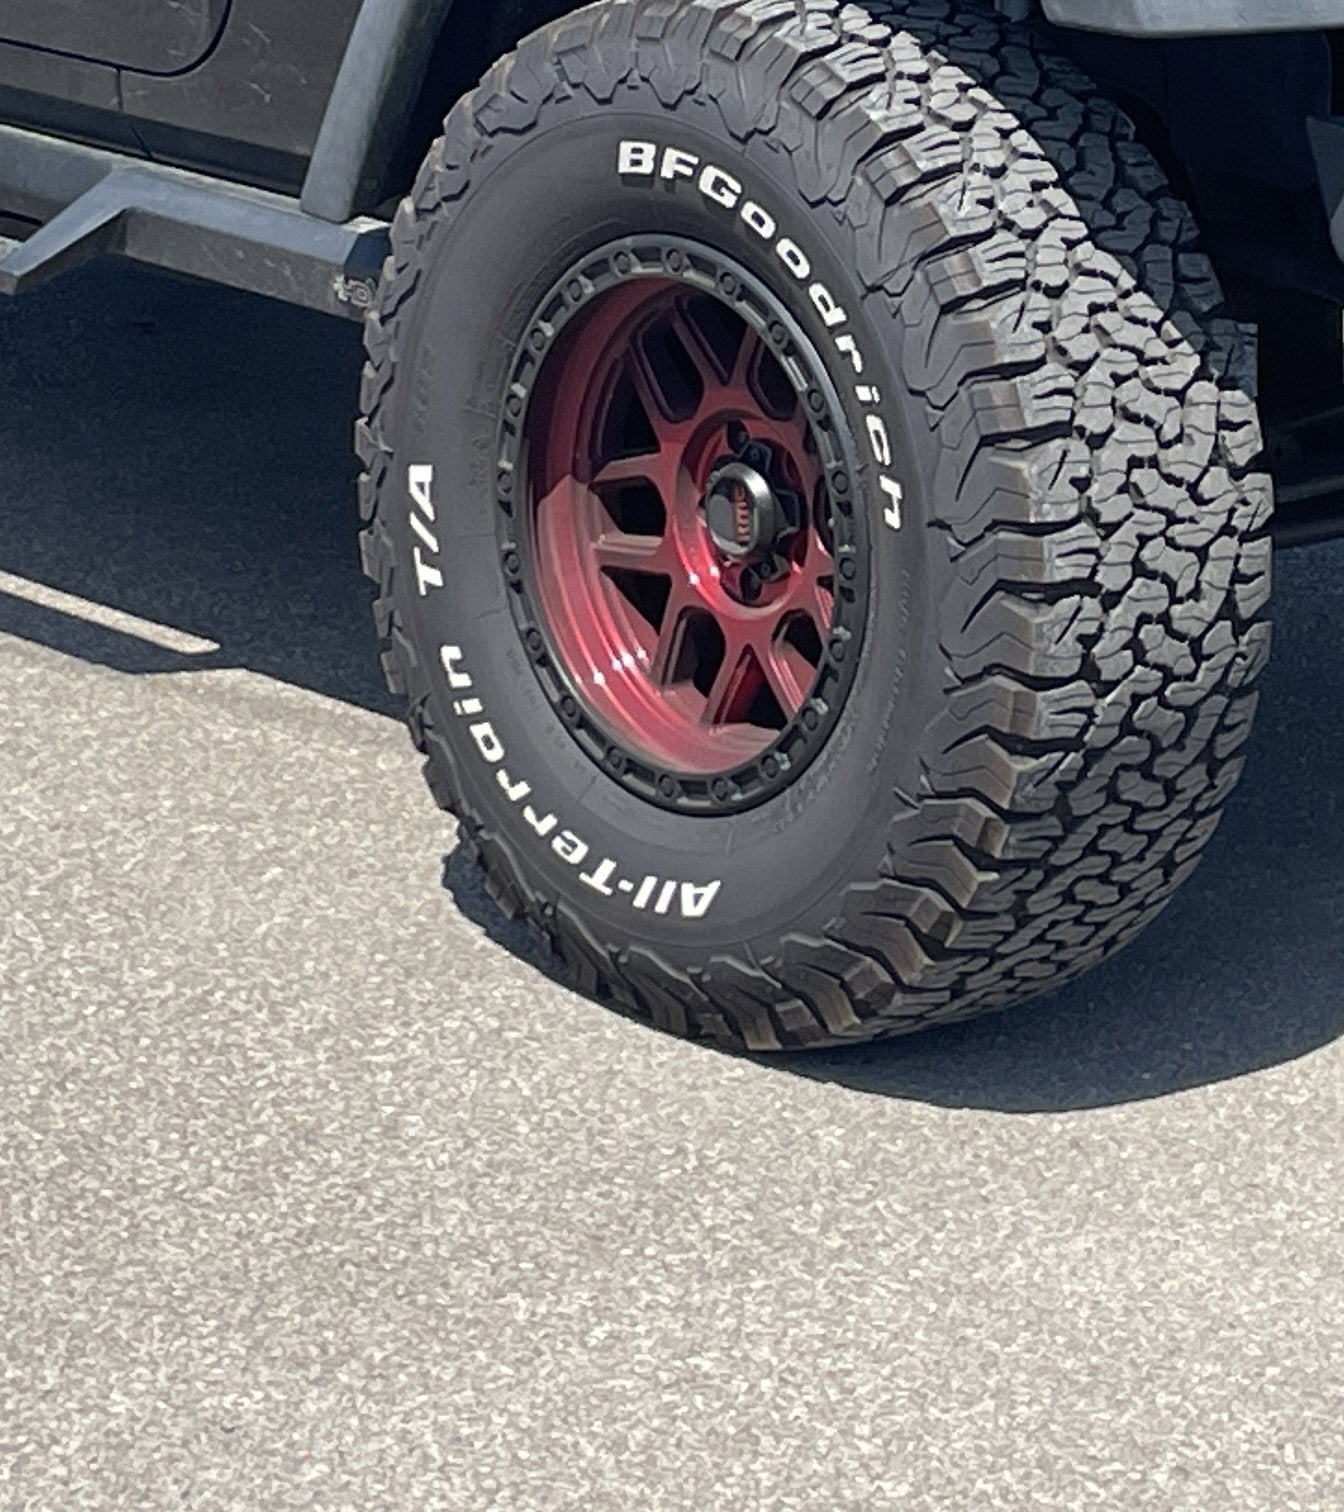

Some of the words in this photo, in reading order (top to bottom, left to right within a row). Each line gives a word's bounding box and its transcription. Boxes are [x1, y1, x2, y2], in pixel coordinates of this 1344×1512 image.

[617, 140, 903, 530] BFGoodrich
[408, 464, 444, 596] T/A
[439, 644, 722, 919] All-Terrain
